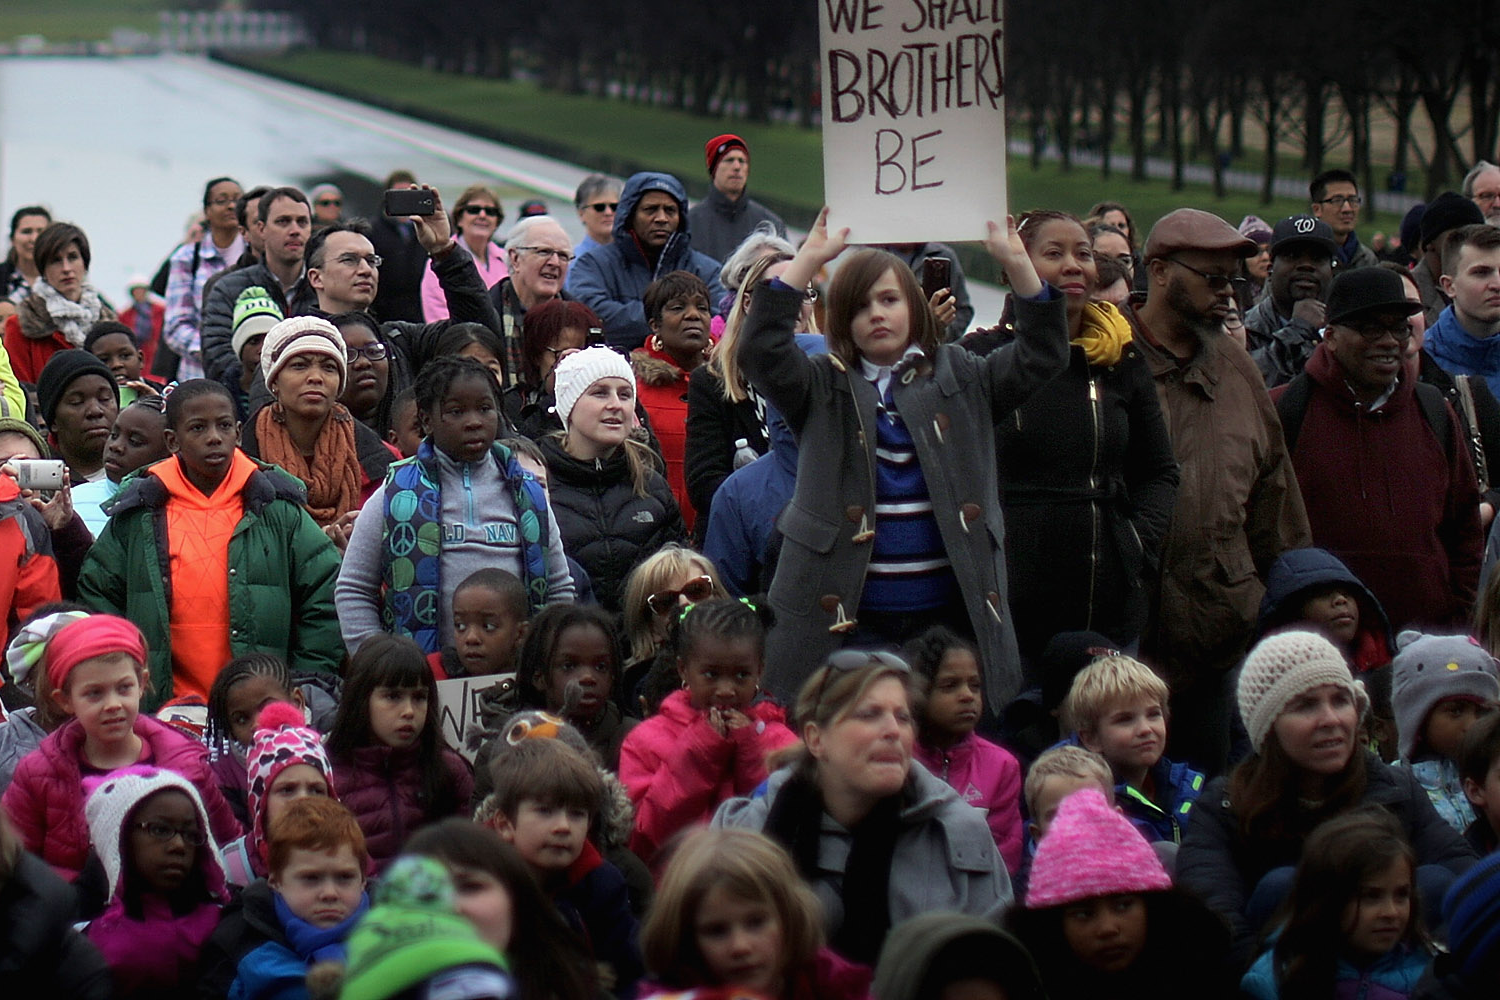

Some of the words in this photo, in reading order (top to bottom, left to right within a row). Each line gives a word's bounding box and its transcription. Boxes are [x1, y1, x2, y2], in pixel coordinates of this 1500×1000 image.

[828, 29, 1004, 123] BROTHERS
[875, 128, 943, 194] BE
[1294, 218, 1316, 233] W
[442, 523, 465, 543] LD
[484, 522, 517, 543] NAV
